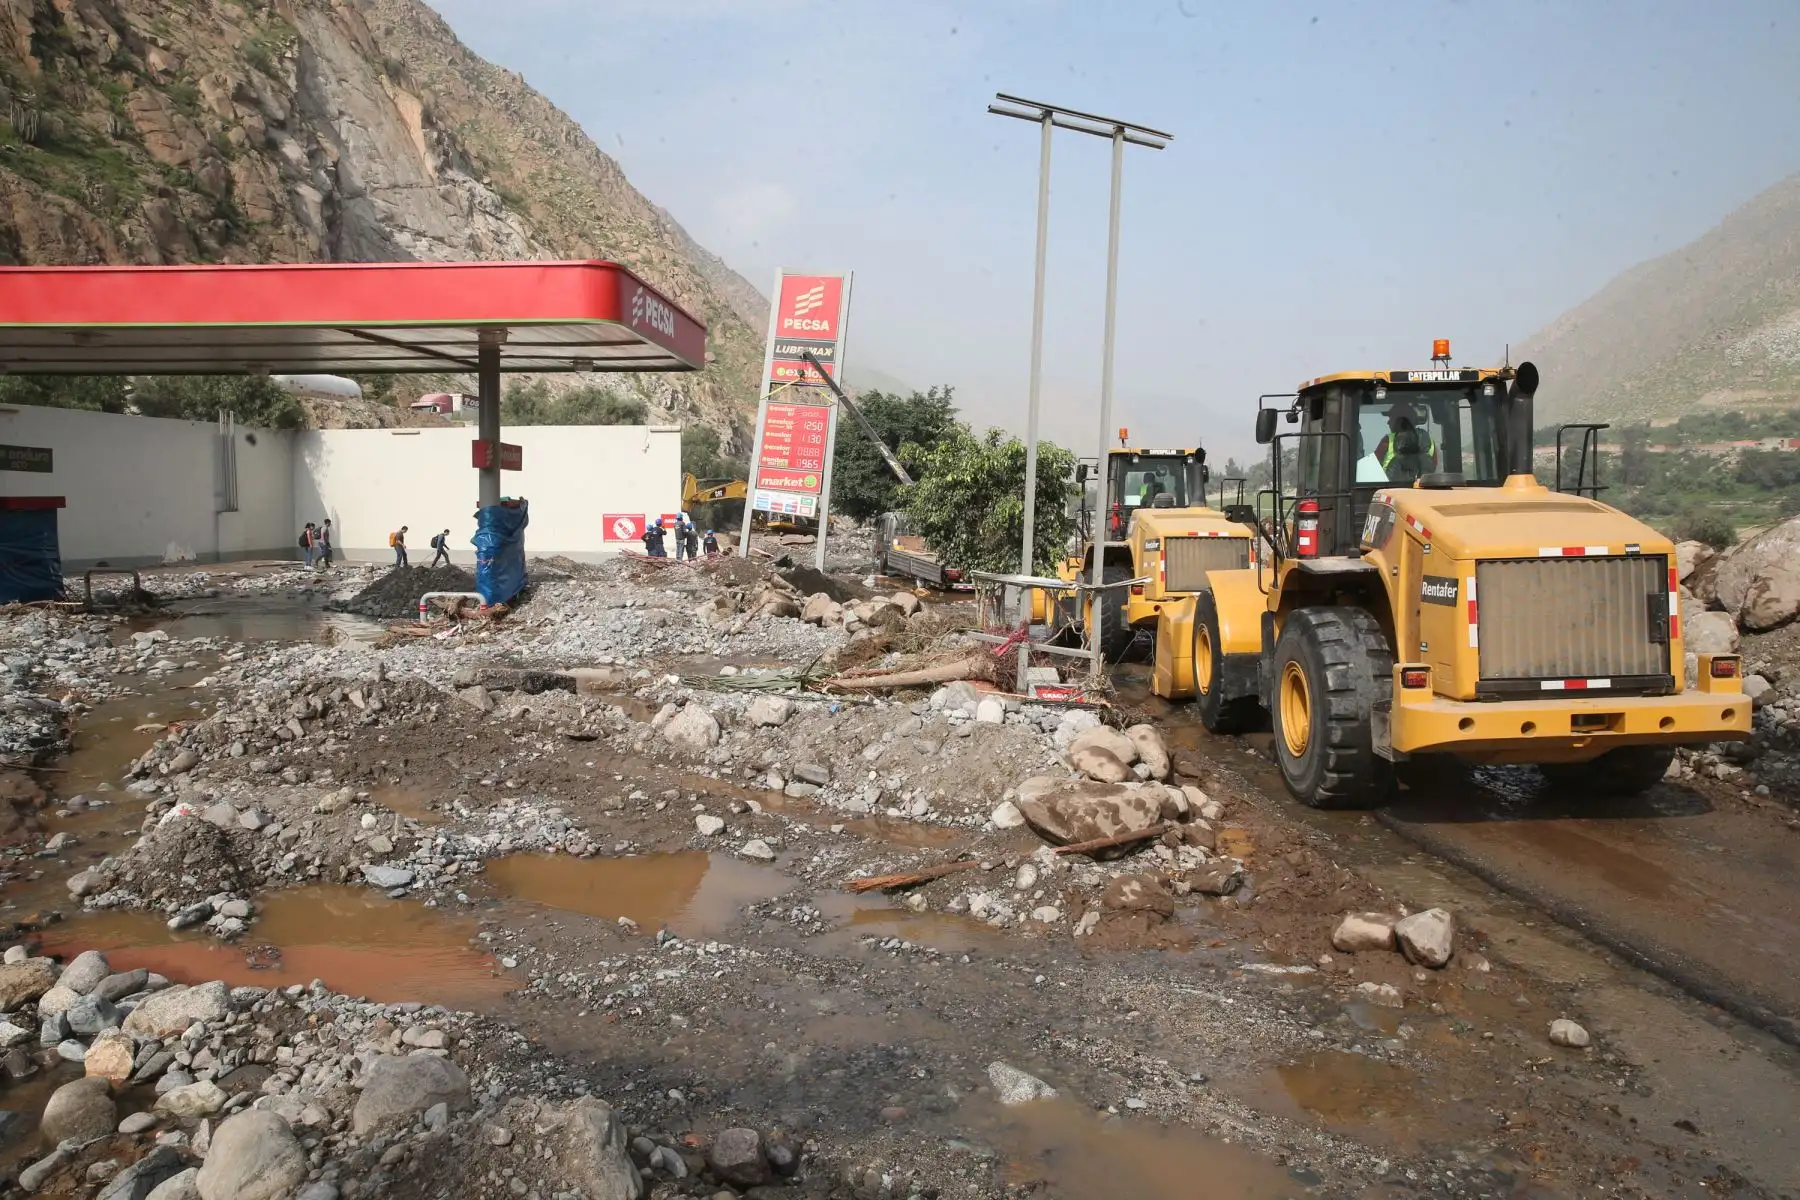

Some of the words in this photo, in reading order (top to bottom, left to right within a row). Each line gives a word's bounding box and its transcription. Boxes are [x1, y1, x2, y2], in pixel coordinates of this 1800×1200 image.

[645, 295, 675, 339] PECSA
[783, 318, 830, 331] PECSA
[1407, 371, 1461, 382] CATERPILLAR
[761, 477, 803, 487] market
[1361, 514, 1381, 544] CAT
[1422, 581, 1458, 598] Rentafer
